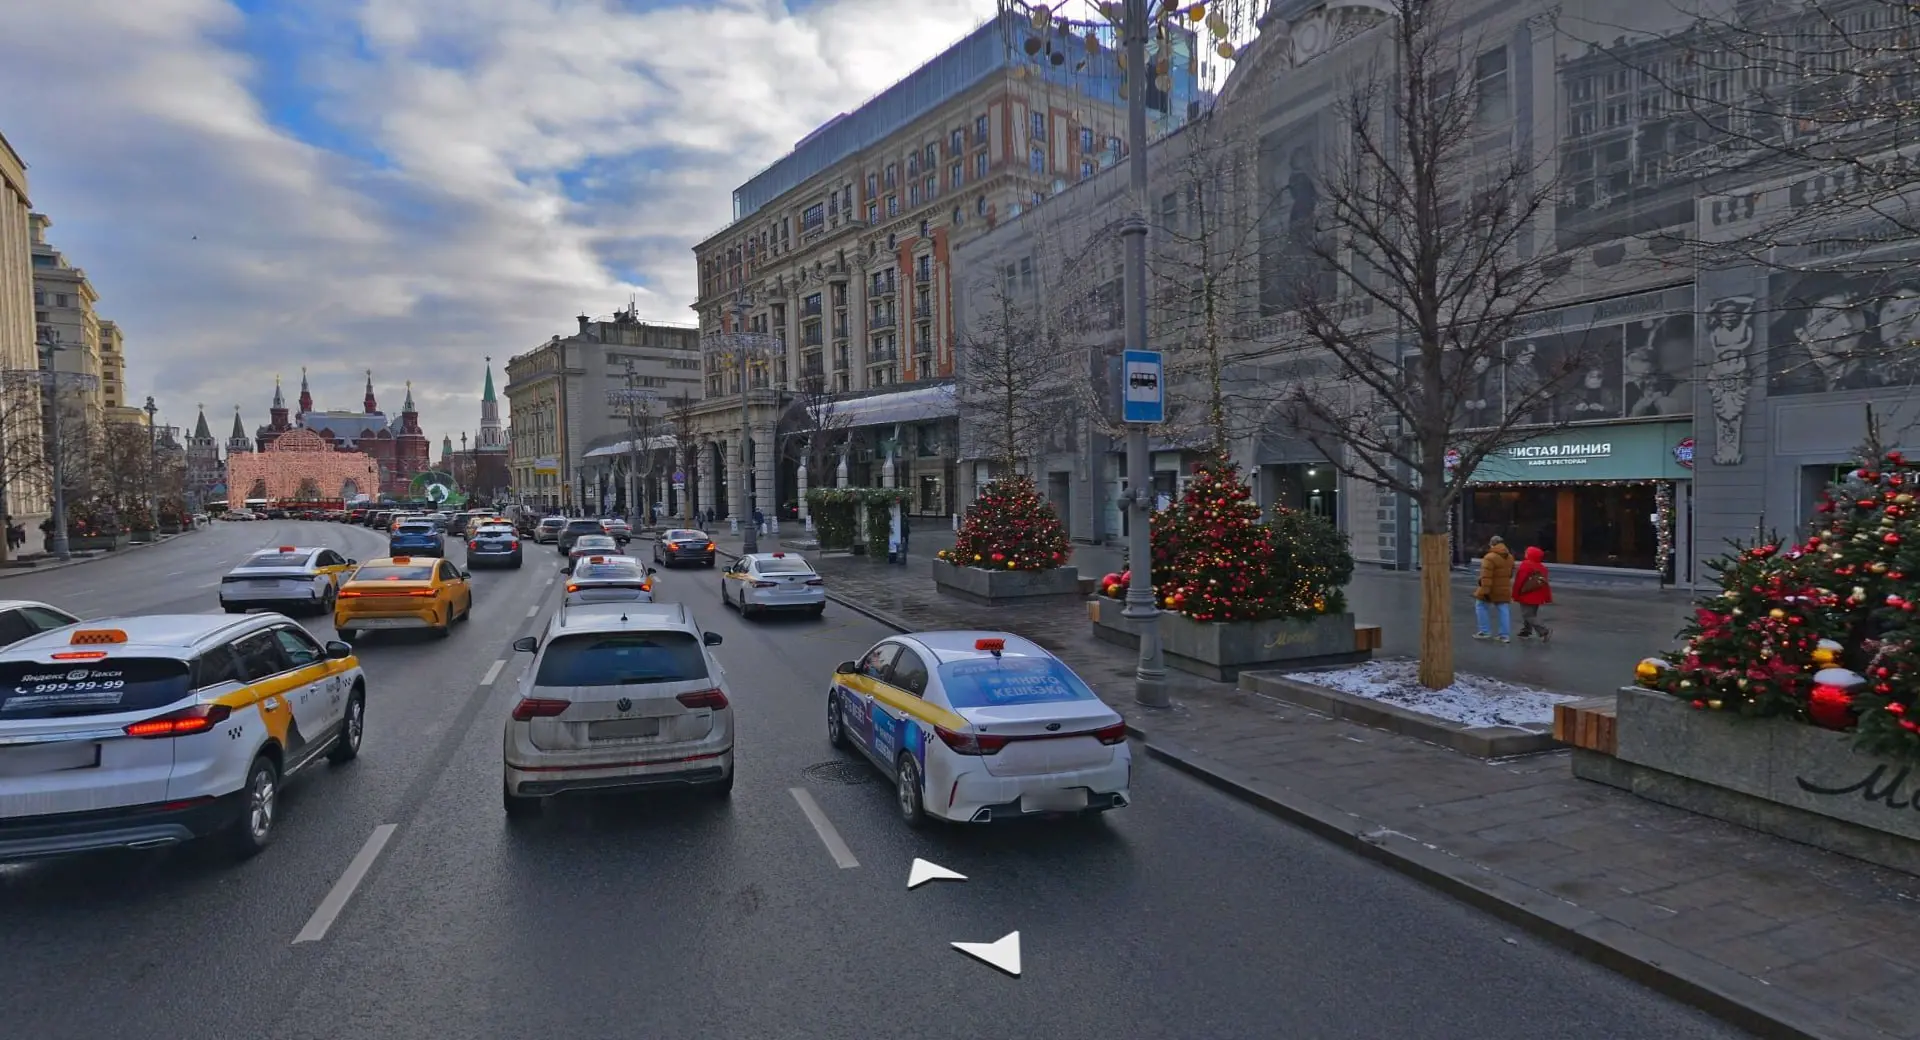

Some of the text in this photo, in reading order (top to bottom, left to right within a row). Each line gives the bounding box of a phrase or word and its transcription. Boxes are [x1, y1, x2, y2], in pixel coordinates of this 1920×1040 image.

[1508, 443, 1611, 457] ЧИСТАЯ ЛИНИЯ
[90, 670, 123, 678] Такси
[34, 680, 124, 693] 999-99-99
[1006, 675, 1059, 686] МНОГО
[993, 685, 1068, 697] КЕШБЭКА
